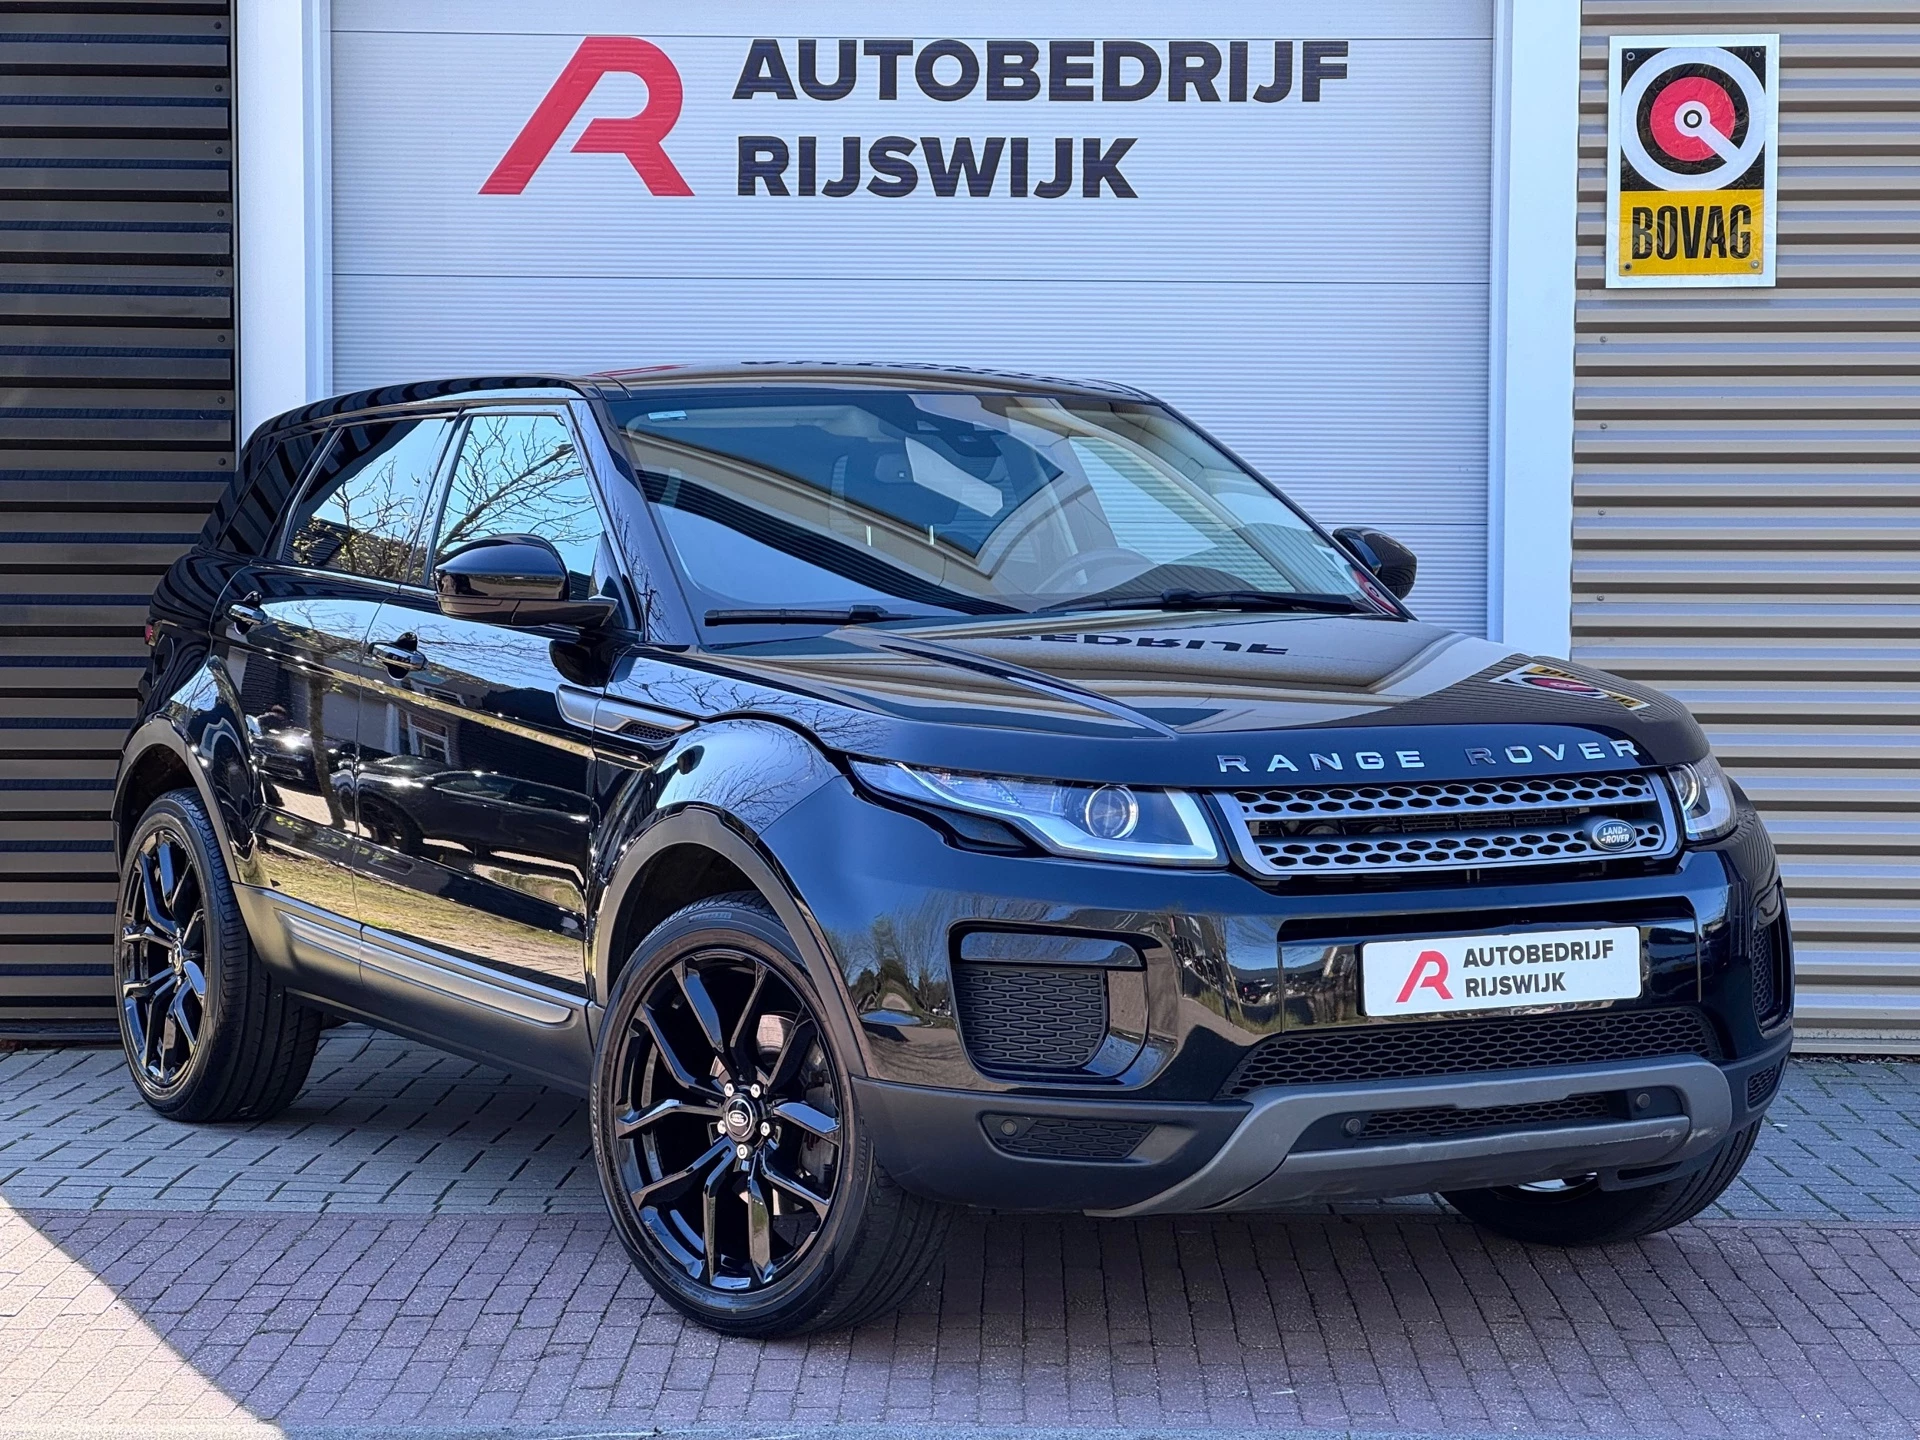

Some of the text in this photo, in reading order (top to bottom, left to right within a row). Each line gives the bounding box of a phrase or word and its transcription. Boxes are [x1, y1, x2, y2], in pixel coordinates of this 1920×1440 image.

[733, 39, 1348, 103] AUTOBEDRIJF
[738, 136, 1138, 198] RIJSWIJK
[1631, 204, 1752, 260] BOVAG
[1216, 739, 1640, 773] RANGE ROVER
[1602, 826, 1623, 836] LAND
[1605, 834, 1630, 843] ROVER
[1463, 939, 1614, 969] AUTOBEDRIJF
[1465, 972, 1566, 998] RIJSWIJK
